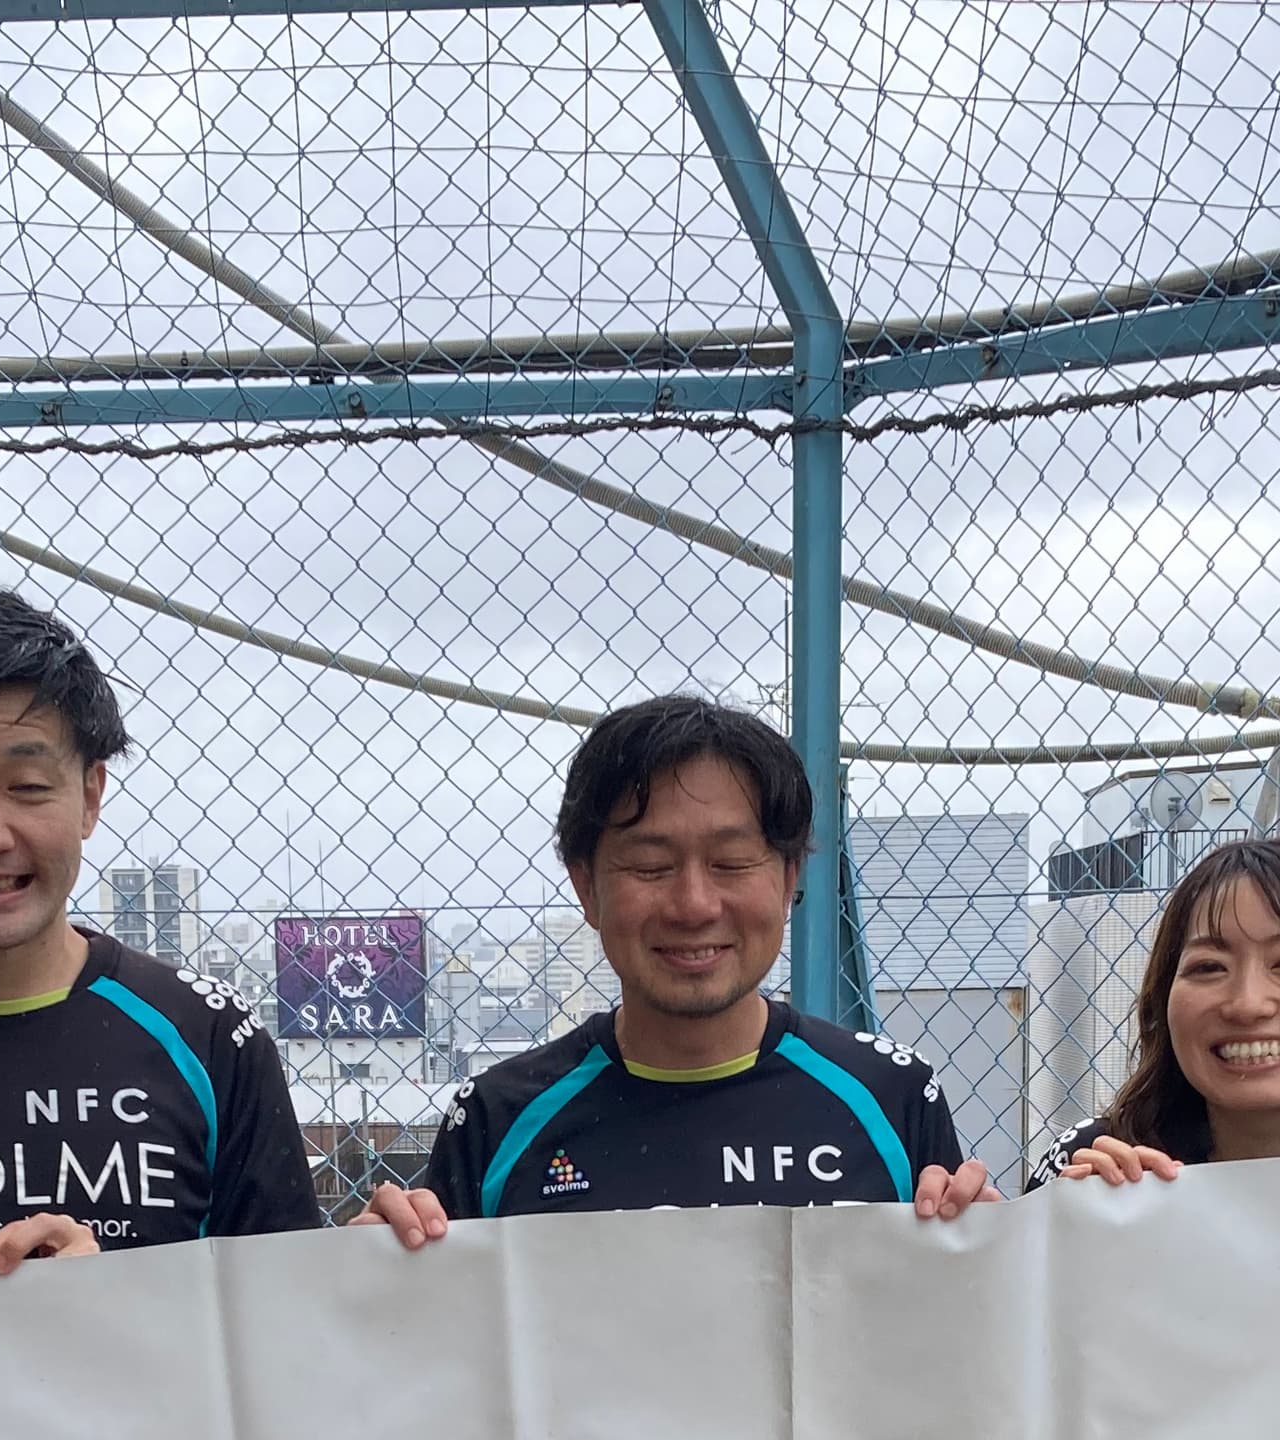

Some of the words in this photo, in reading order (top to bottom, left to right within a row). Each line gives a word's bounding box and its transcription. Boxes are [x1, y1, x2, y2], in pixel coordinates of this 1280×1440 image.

[302, 925, 397, 946] HOTEL
[300, 1004, 404, 1031] SARA
[542, 1180, 590, 1195] svolme
